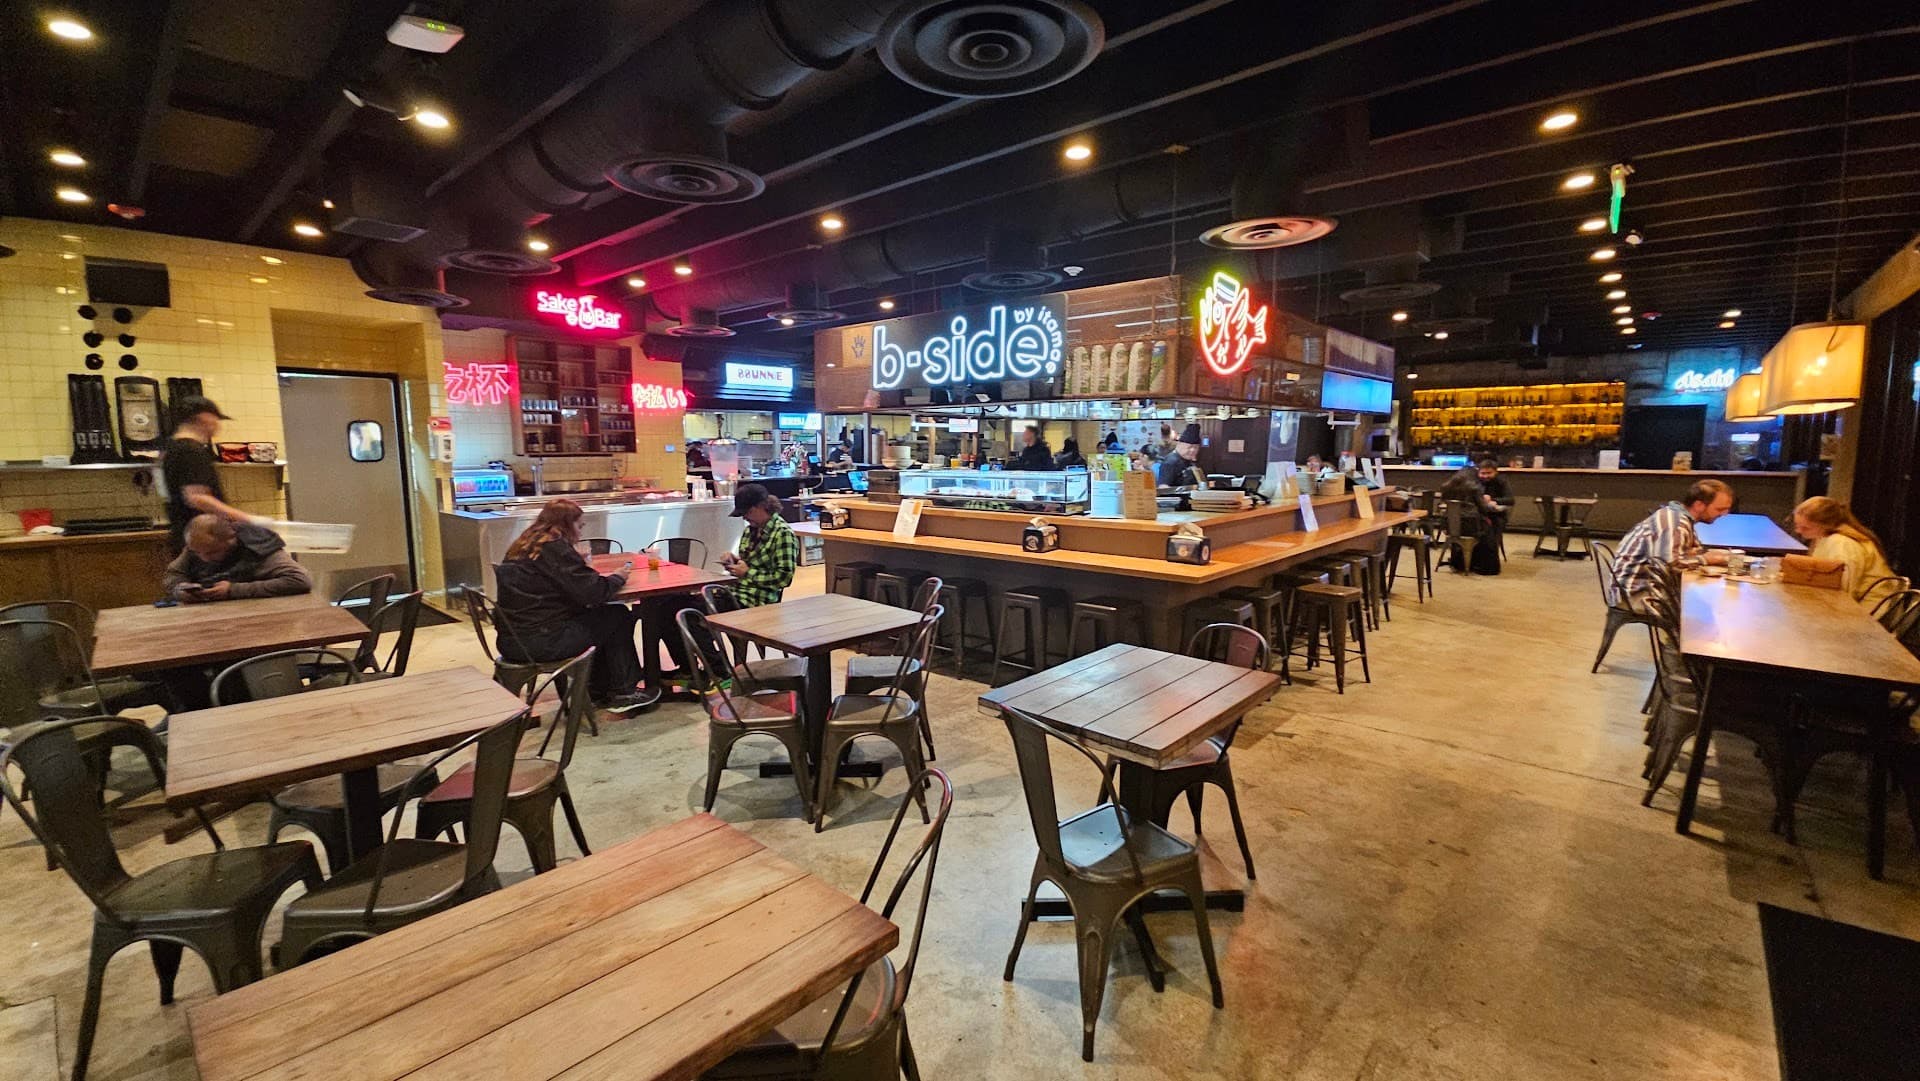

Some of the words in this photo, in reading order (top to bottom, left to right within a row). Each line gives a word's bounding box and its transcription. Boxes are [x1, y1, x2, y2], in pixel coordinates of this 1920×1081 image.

[537, 291, 578, 313] Sake
[594, 308, 621, 328] Bar
[1013, 306, 1035, 324] by
[873, 305, 1049, 389] b-side
